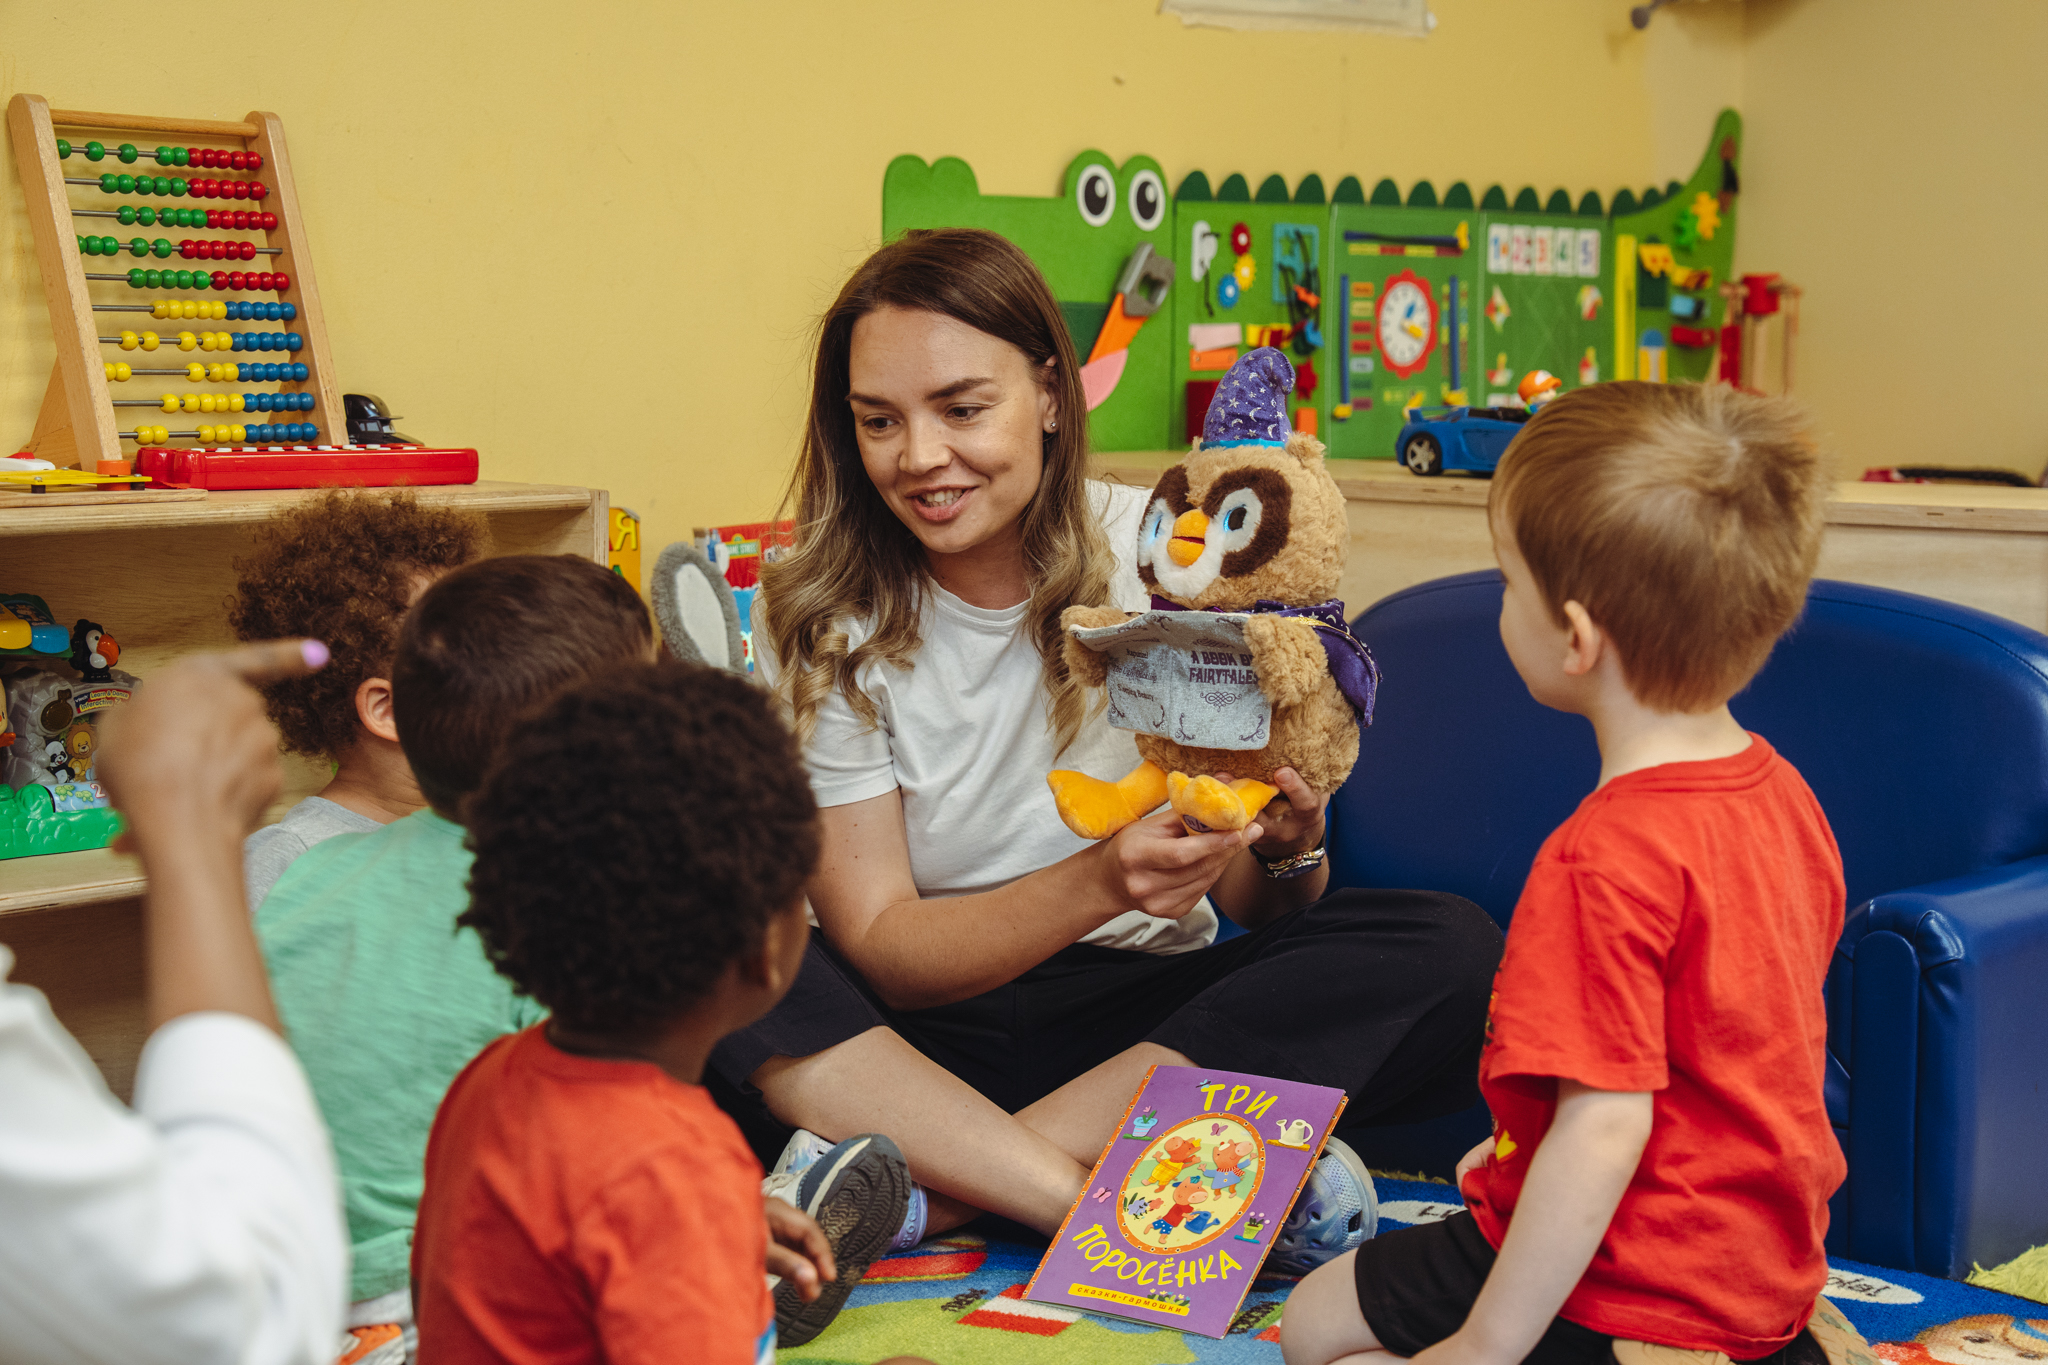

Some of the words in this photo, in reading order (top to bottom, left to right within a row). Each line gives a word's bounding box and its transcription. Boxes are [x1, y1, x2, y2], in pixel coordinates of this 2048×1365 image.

[609, 511, 637, 551] Я
[1191, 650, 1200, 664] A
[1201, 651, 1238, 666] BOOK
[1189, 667, 1260, 685] FAIRYTALES
[90, 691, 106, 699] Learn
[112, 690, 129, 699] Dance
[80, 699, 113, 711] Interactive
[90, 783, 106, 799] 2
[1200, 1084, 1279, 1120] ТРИ
[1072, 1224, 1242, 1288] ПОРОСЁНКА
[1827, 1276, 1890, 1297] ola!
[1077, 1287, 1182, 1313] сказки-гармошки
